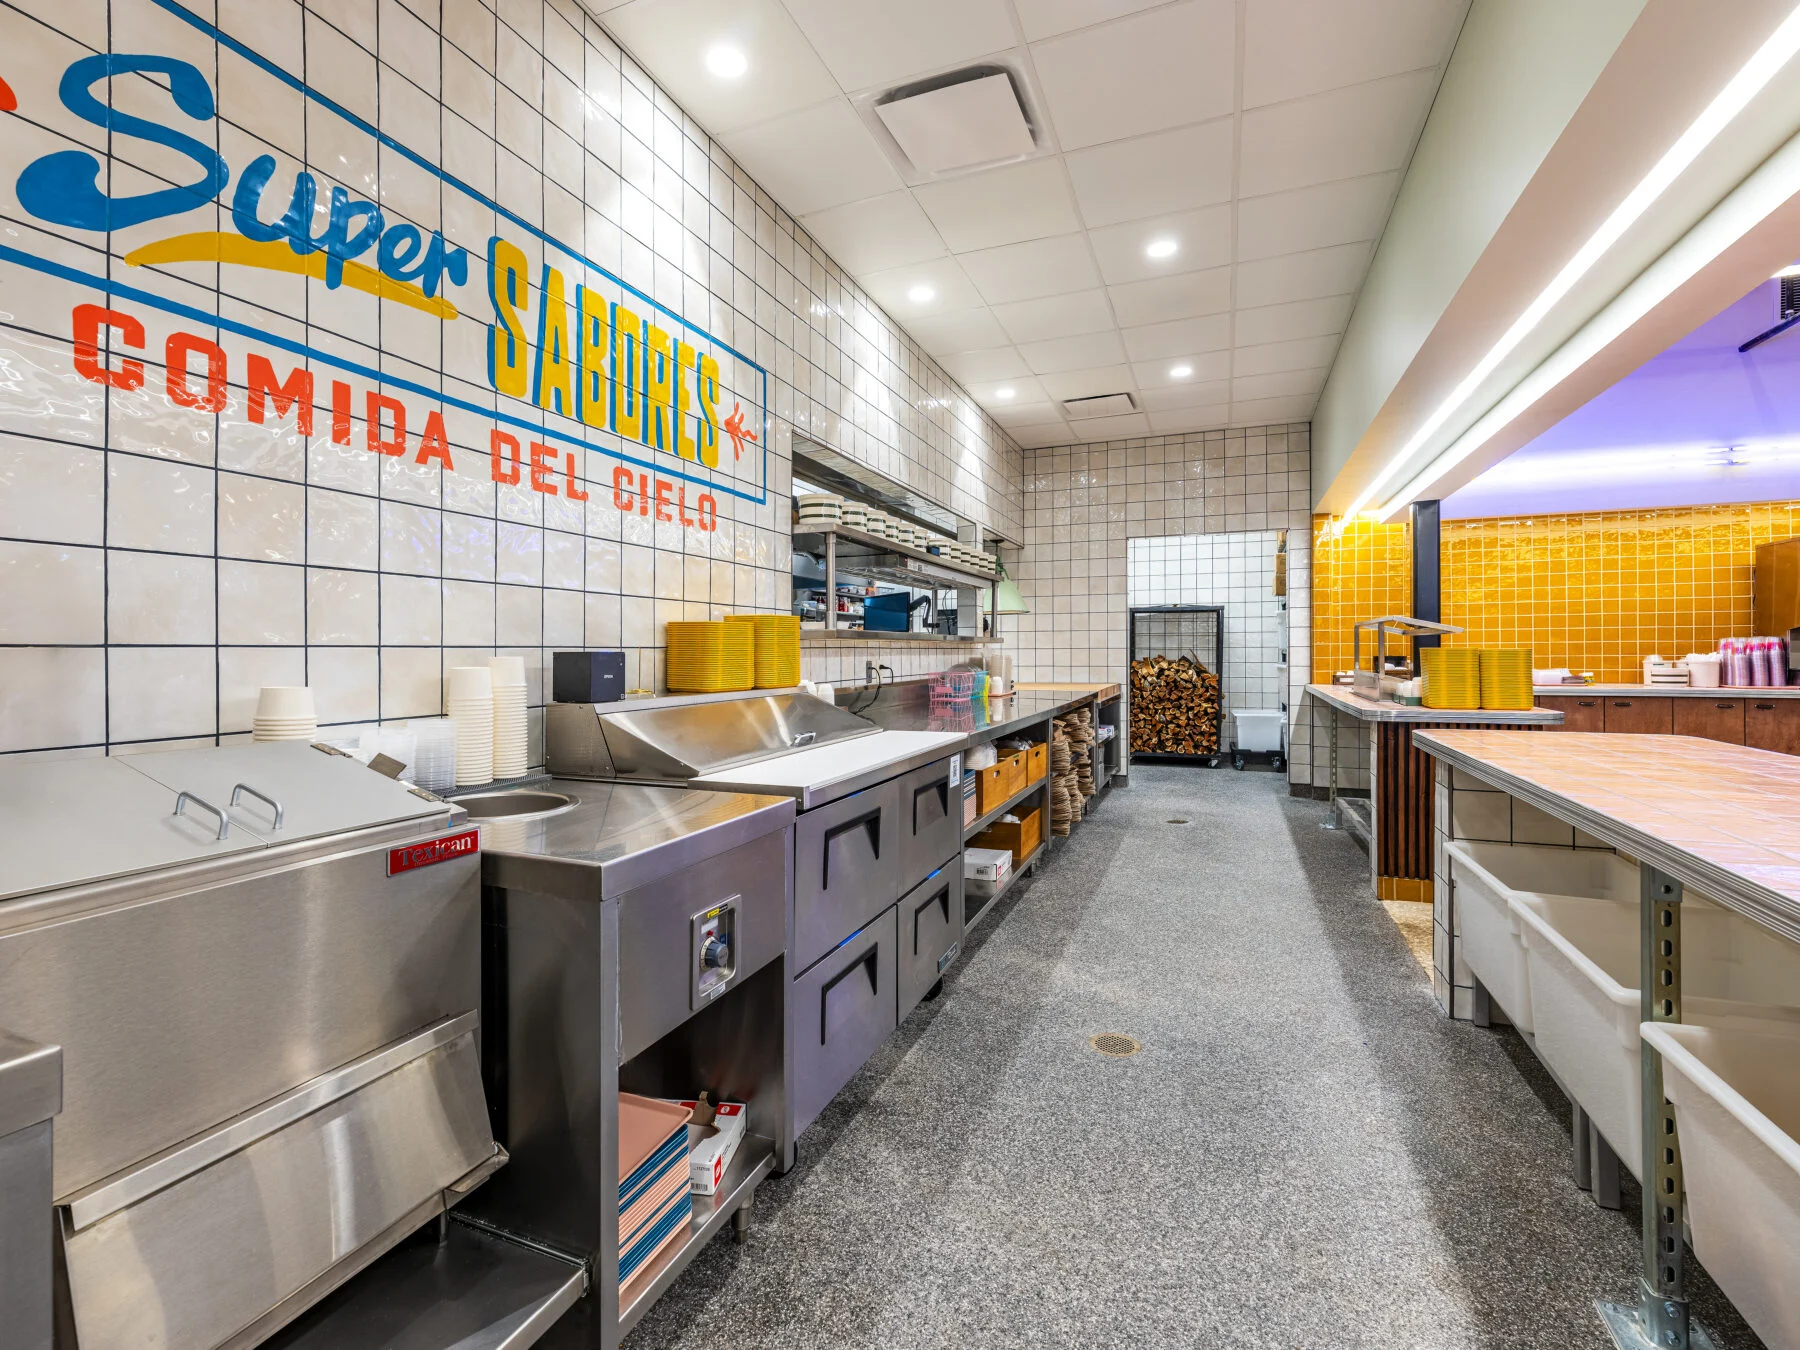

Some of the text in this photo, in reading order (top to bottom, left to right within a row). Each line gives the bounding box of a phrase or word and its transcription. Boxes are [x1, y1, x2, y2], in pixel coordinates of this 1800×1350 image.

[16, 53, 720, 469] Super SABORES
[72, 304, 717, 533] COMIDA DEL CIELO
[398, 836, 472, 867] Texican
